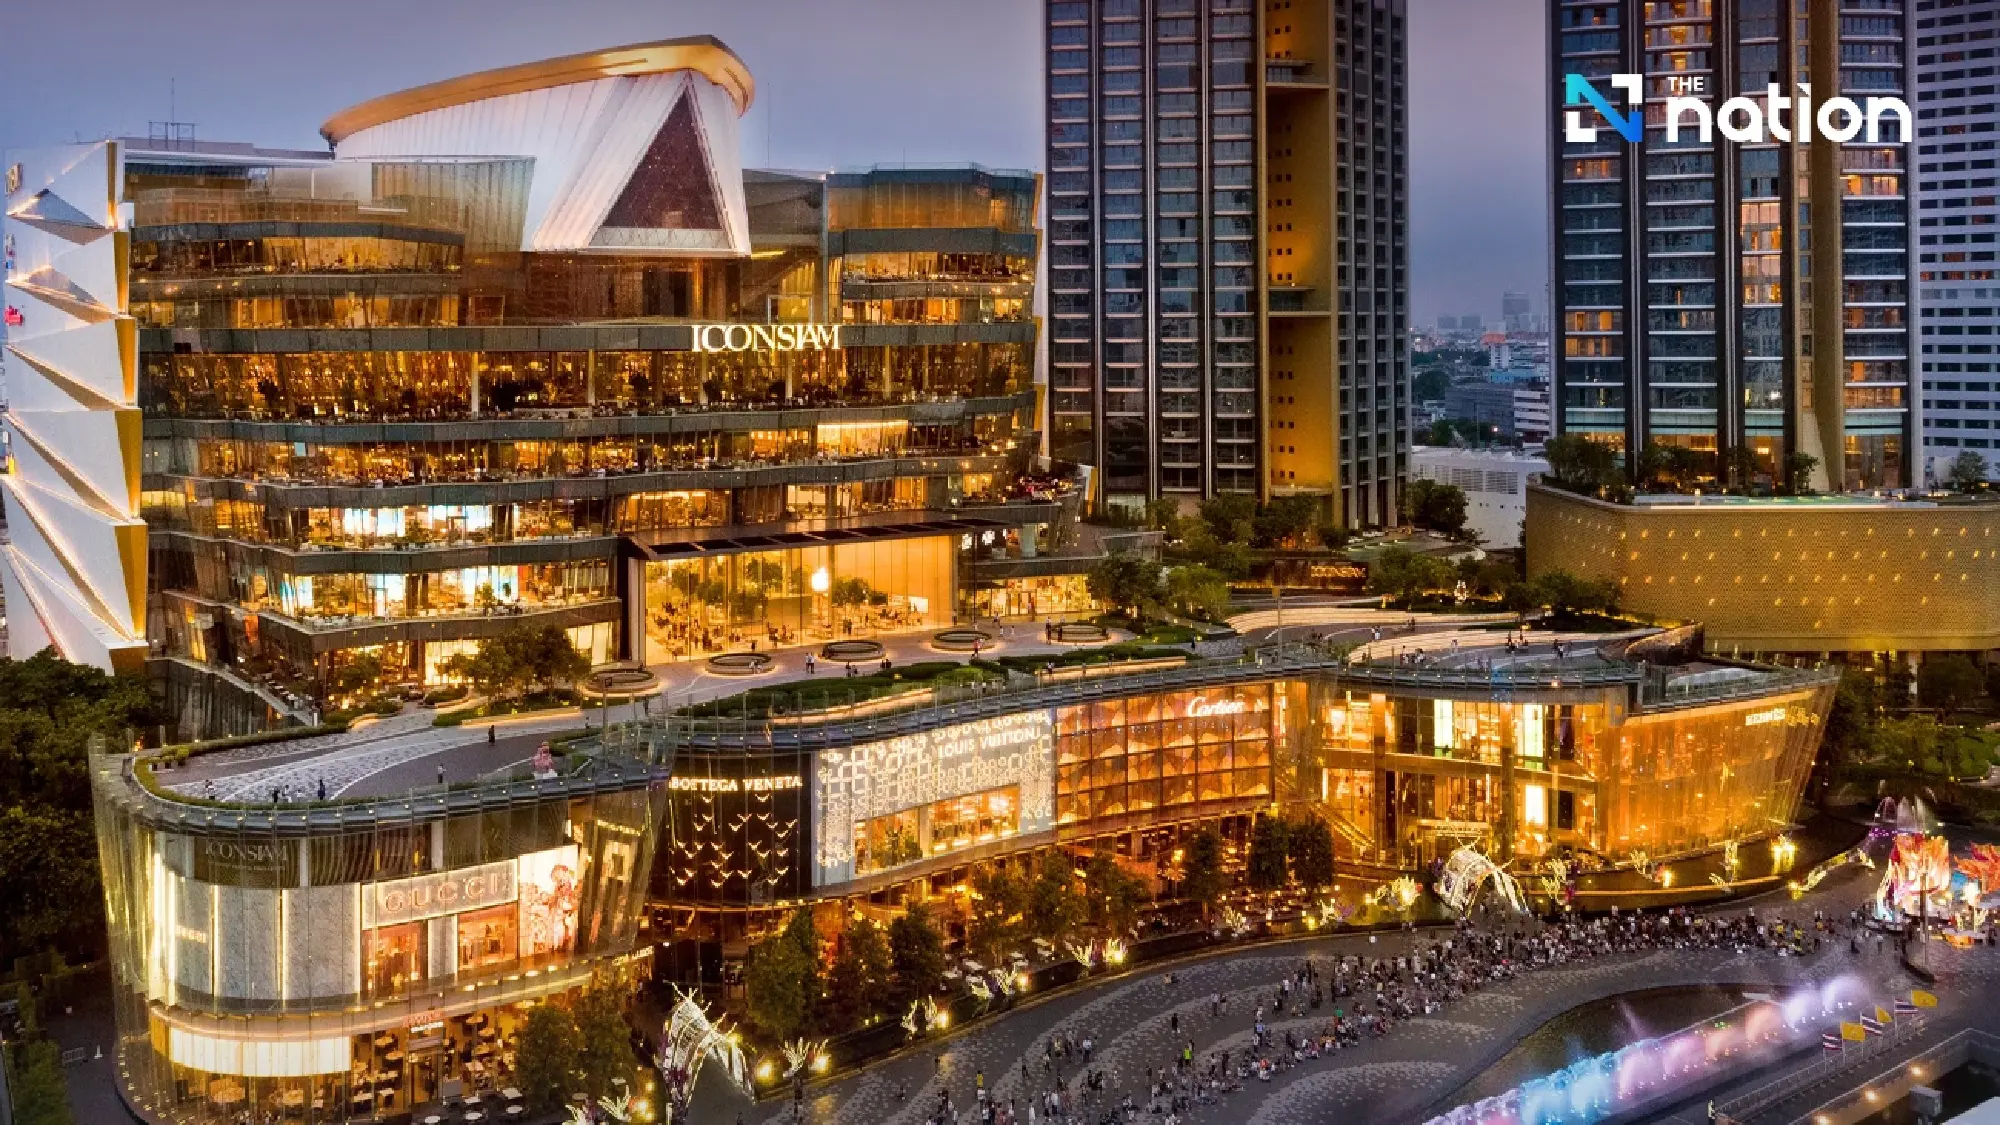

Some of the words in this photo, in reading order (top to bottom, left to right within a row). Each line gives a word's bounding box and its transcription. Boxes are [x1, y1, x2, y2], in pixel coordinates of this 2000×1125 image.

[691, 324, 842, 352] ICONSIAM
[1187, 695, 1246, 717] Cartier
[937, 738, 975, 758] LOUIS
[980, 726, 1041, 750] VUITTON
[669, 776, 738, 792] BOTTEGA
[742, 775, 802, 792] VENETA
[385, 873, 500, 912] GUCCI
